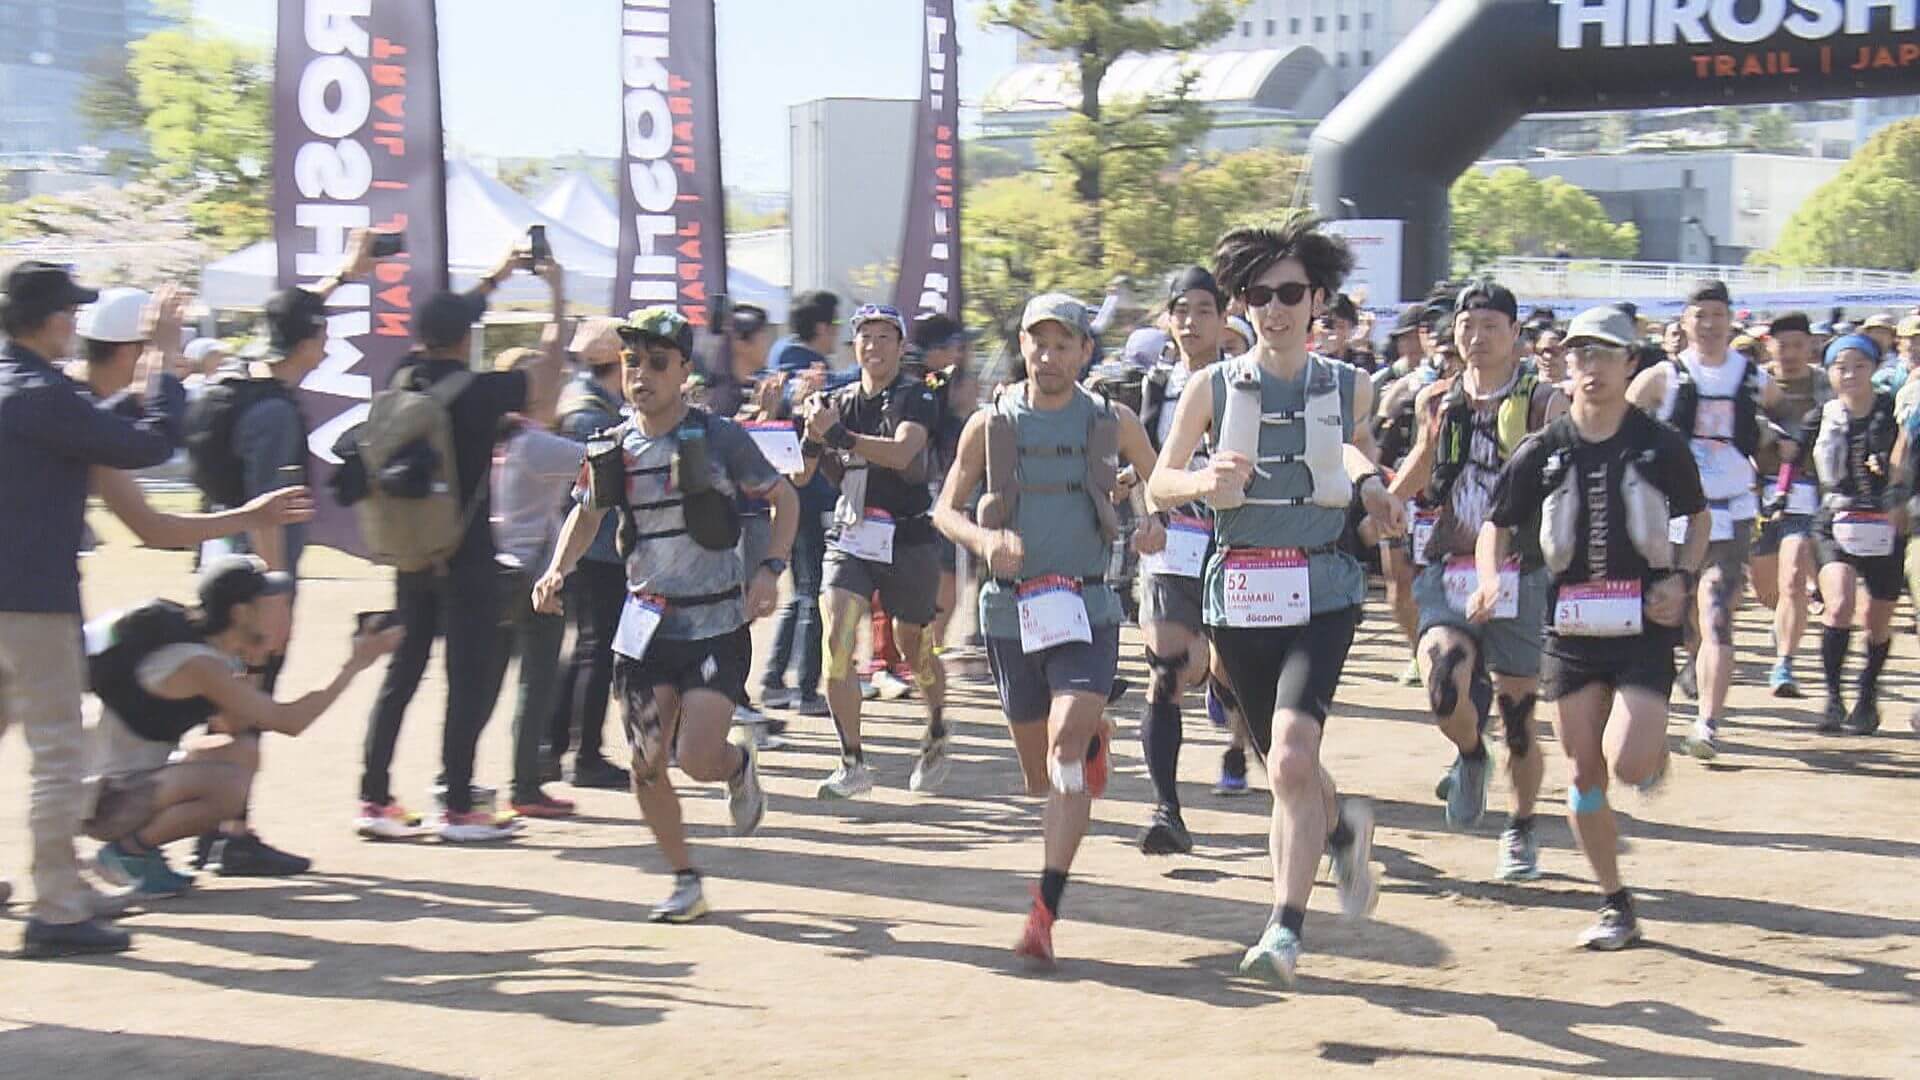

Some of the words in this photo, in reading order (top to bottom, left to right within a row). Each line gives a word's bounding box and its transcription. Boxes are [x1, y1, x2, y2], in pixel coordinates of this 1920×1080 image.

[1691, 52, 1799, 78] TRAIL
[1586, 462, 1609, 580] MERRELL
[1227, 572, 1248, 591] 52
